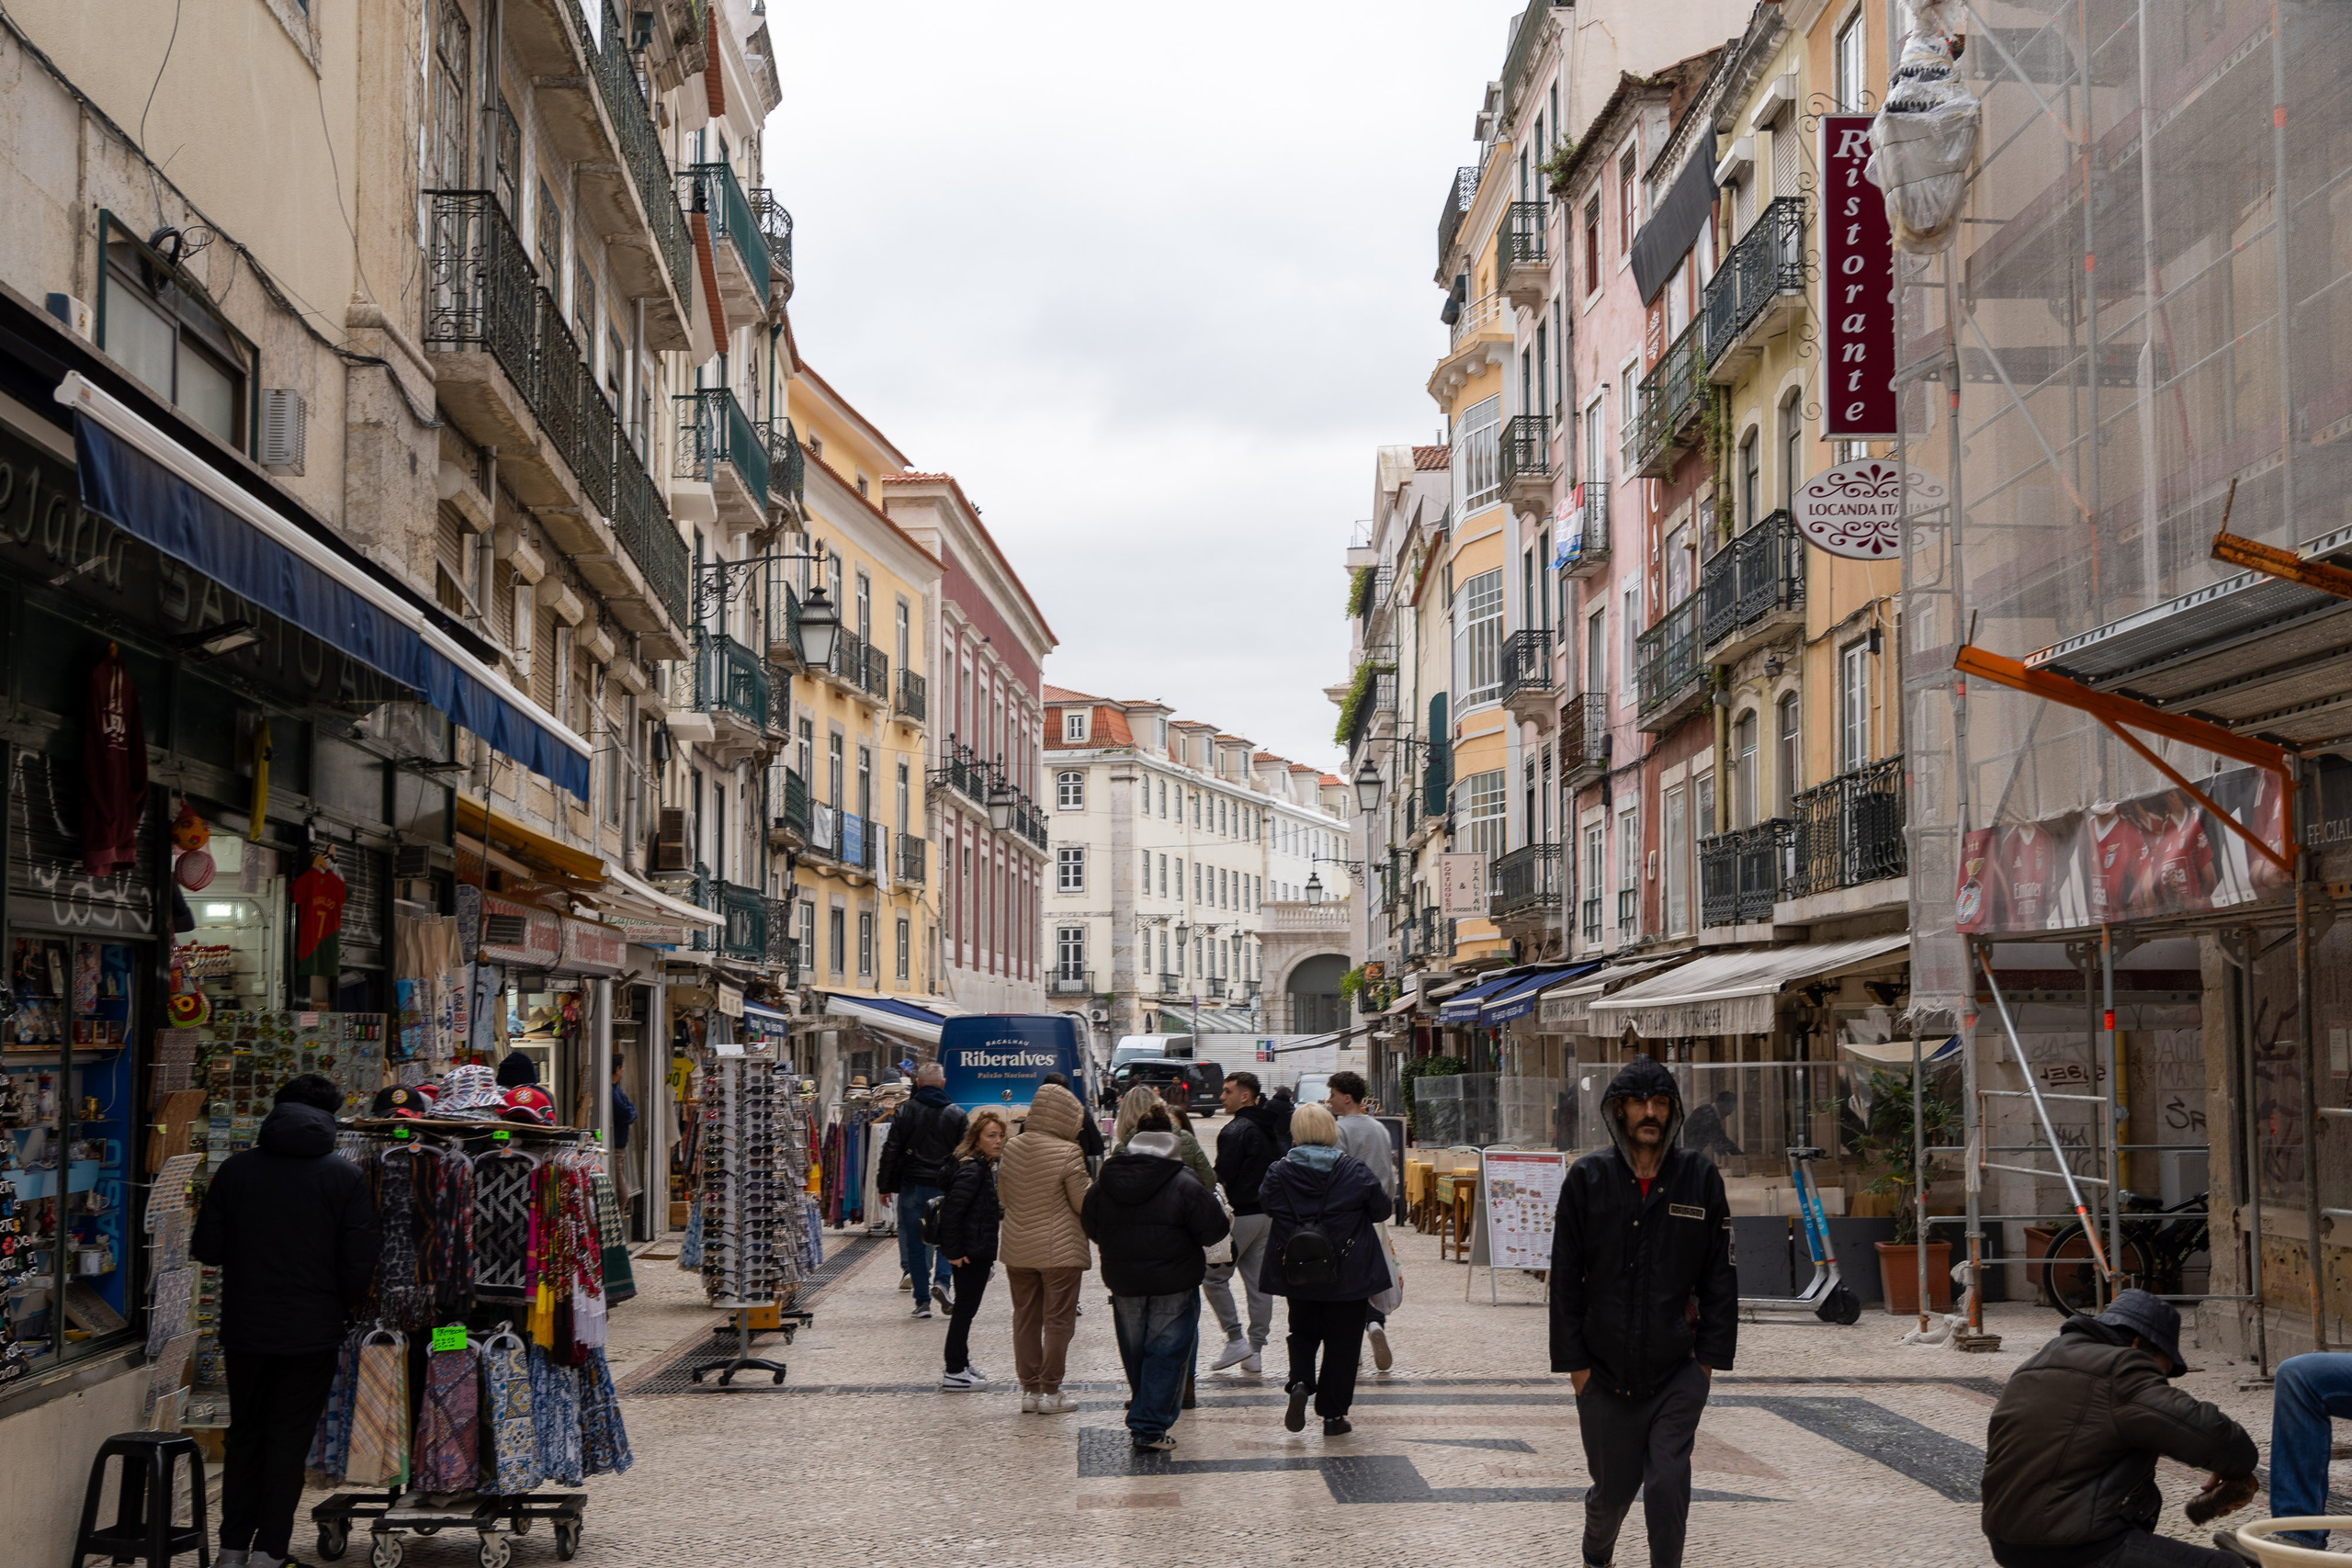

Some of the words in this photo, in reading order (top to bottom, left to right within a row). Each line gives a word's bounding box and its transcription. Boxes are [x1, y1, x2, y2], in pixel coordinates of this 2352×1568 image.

[1832, 129, 1870, 423] Ristorante
[1809, 503, 1877, 516] LOCANDA
[2300, 818, 2352, 846] FFCIAL
[1459, 882, 1466, 890] &
[1472, 861, 1481, 912] ITALIAN
[985, 1039, 1030, 1047] BACALHAU
[960, 1050, 1056, 1066] Riberalves
[978, 1071, 1002, 1079] Paixão
[1004, 1071, 1037, 1079] Nacional
[1803, 1202, 1814, 1230] BIRD
